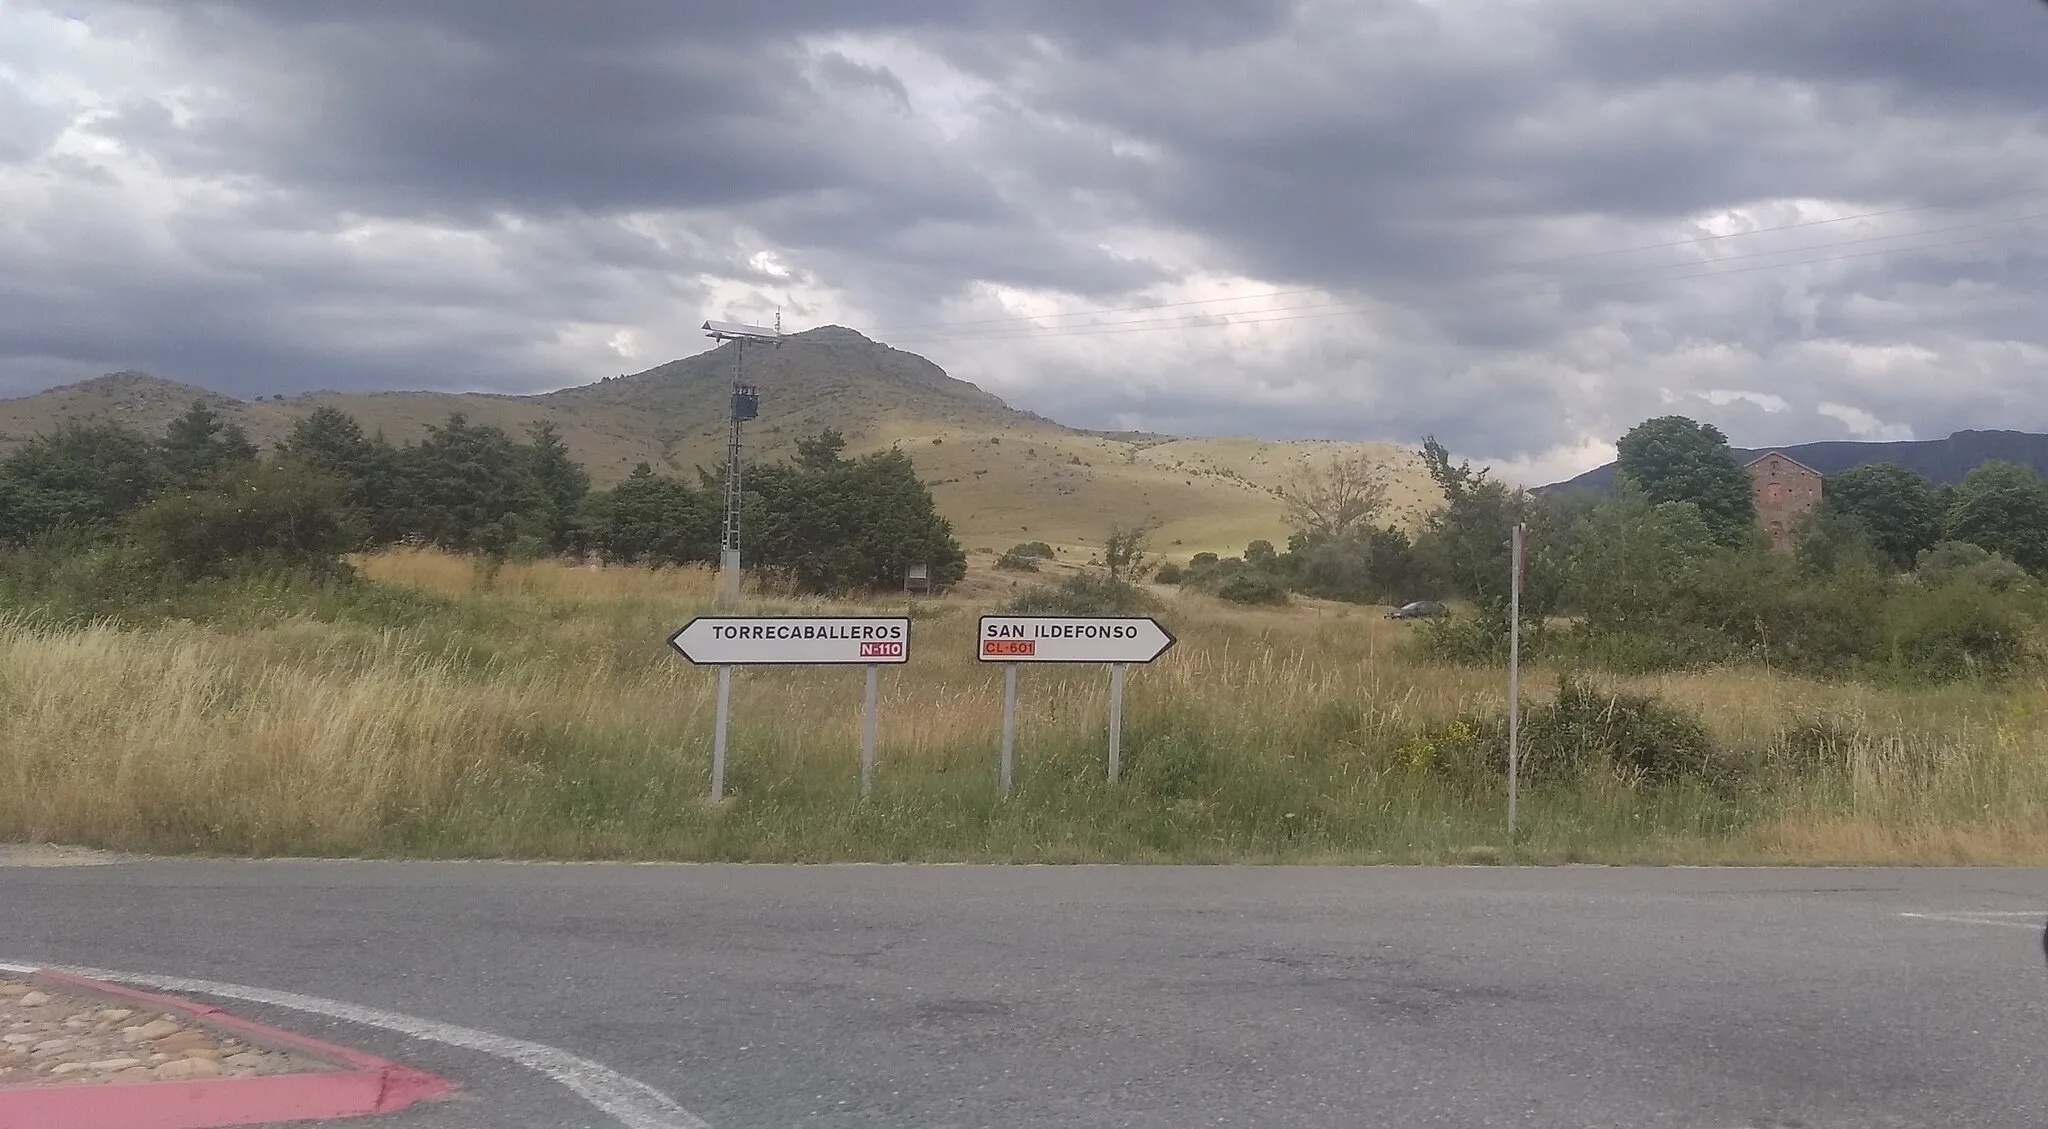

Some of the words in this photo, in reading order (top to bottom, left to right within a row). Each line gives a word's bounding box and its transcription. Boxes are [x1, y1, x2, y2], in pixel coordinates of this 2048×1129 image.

[712, 625, 902, 640] TORRECABALLEROS
[986, 624, 1025, 638] SAN
[1034, 625, 1138, 639] ILDEFONSO
[861, 643, 902, 656] N-110
[985, 642, 1034, 654] CL-601
